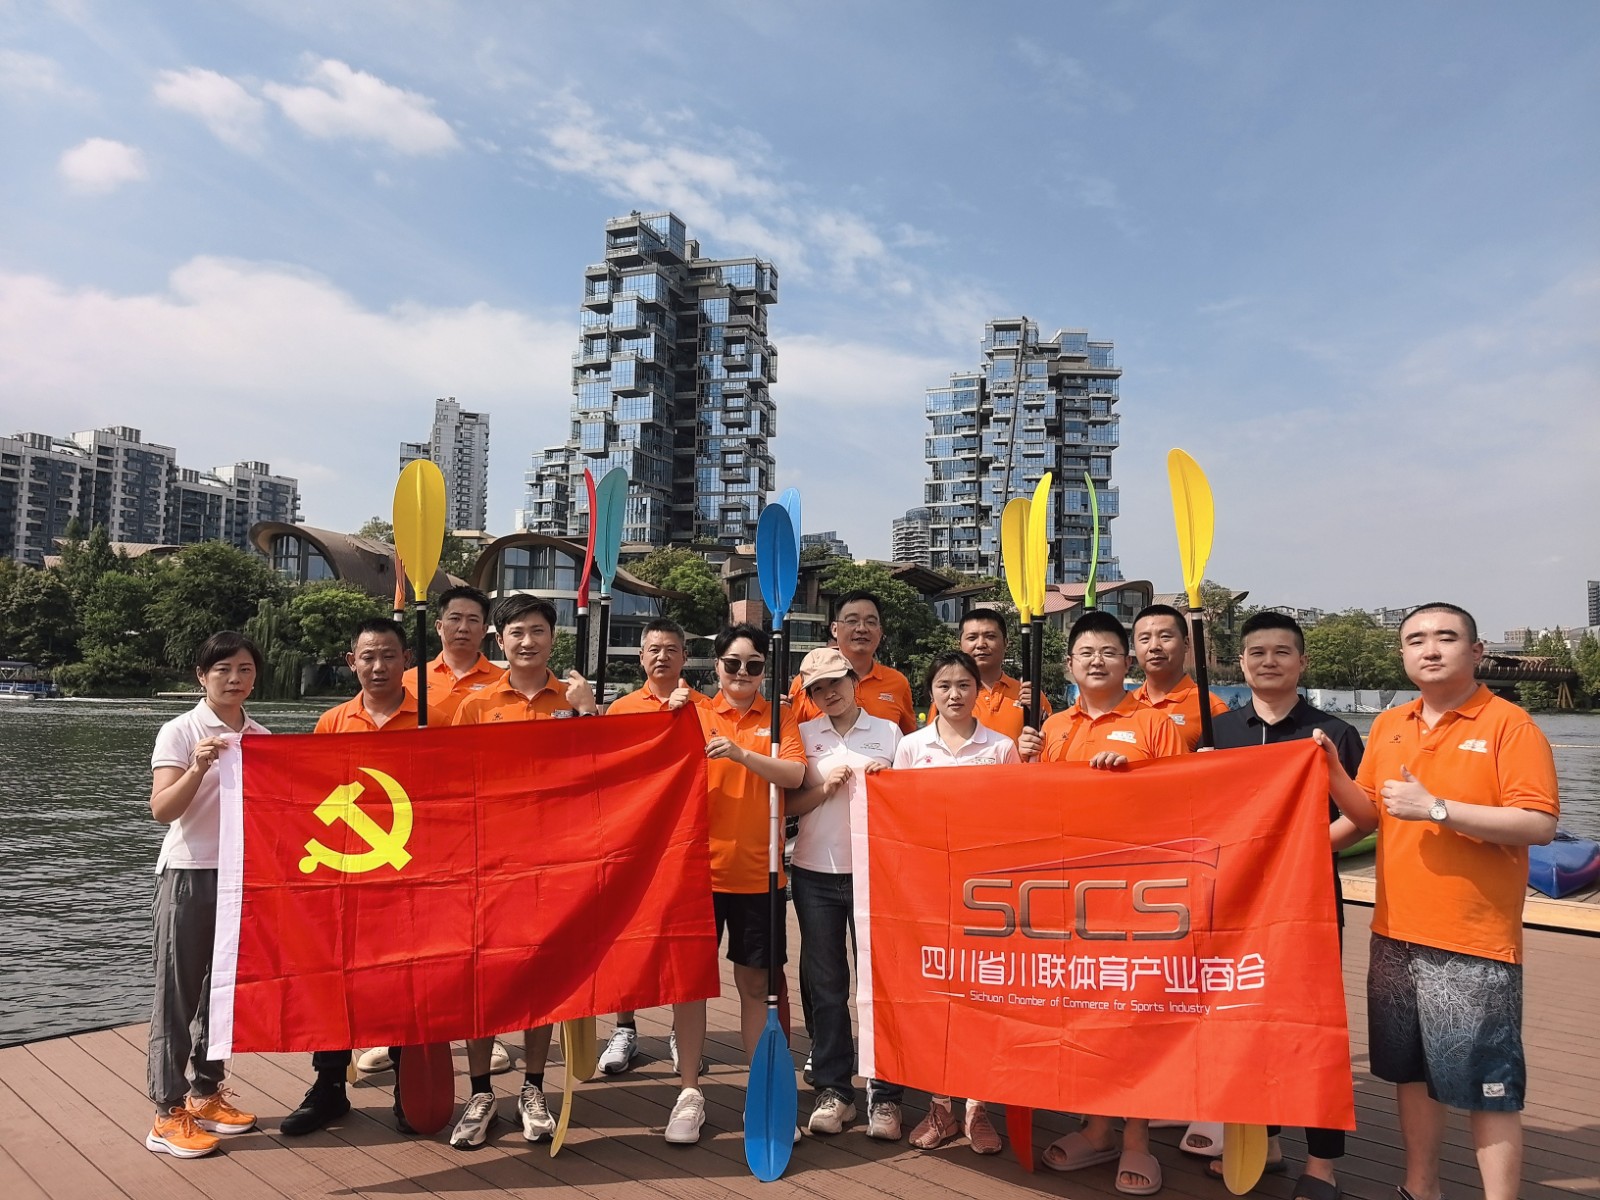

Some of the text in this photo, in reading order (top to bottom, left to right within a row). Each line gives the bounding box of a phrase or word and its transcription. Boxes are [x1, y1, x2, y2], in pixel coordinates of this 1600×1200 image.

[963, 878, 1190, 941] SCCS
[921, 945, 1265, 993] 四川省川联体育产业商会
[969, 989, 1211, 1016] Sichuan Chamber of Commerce for Sports Industry
